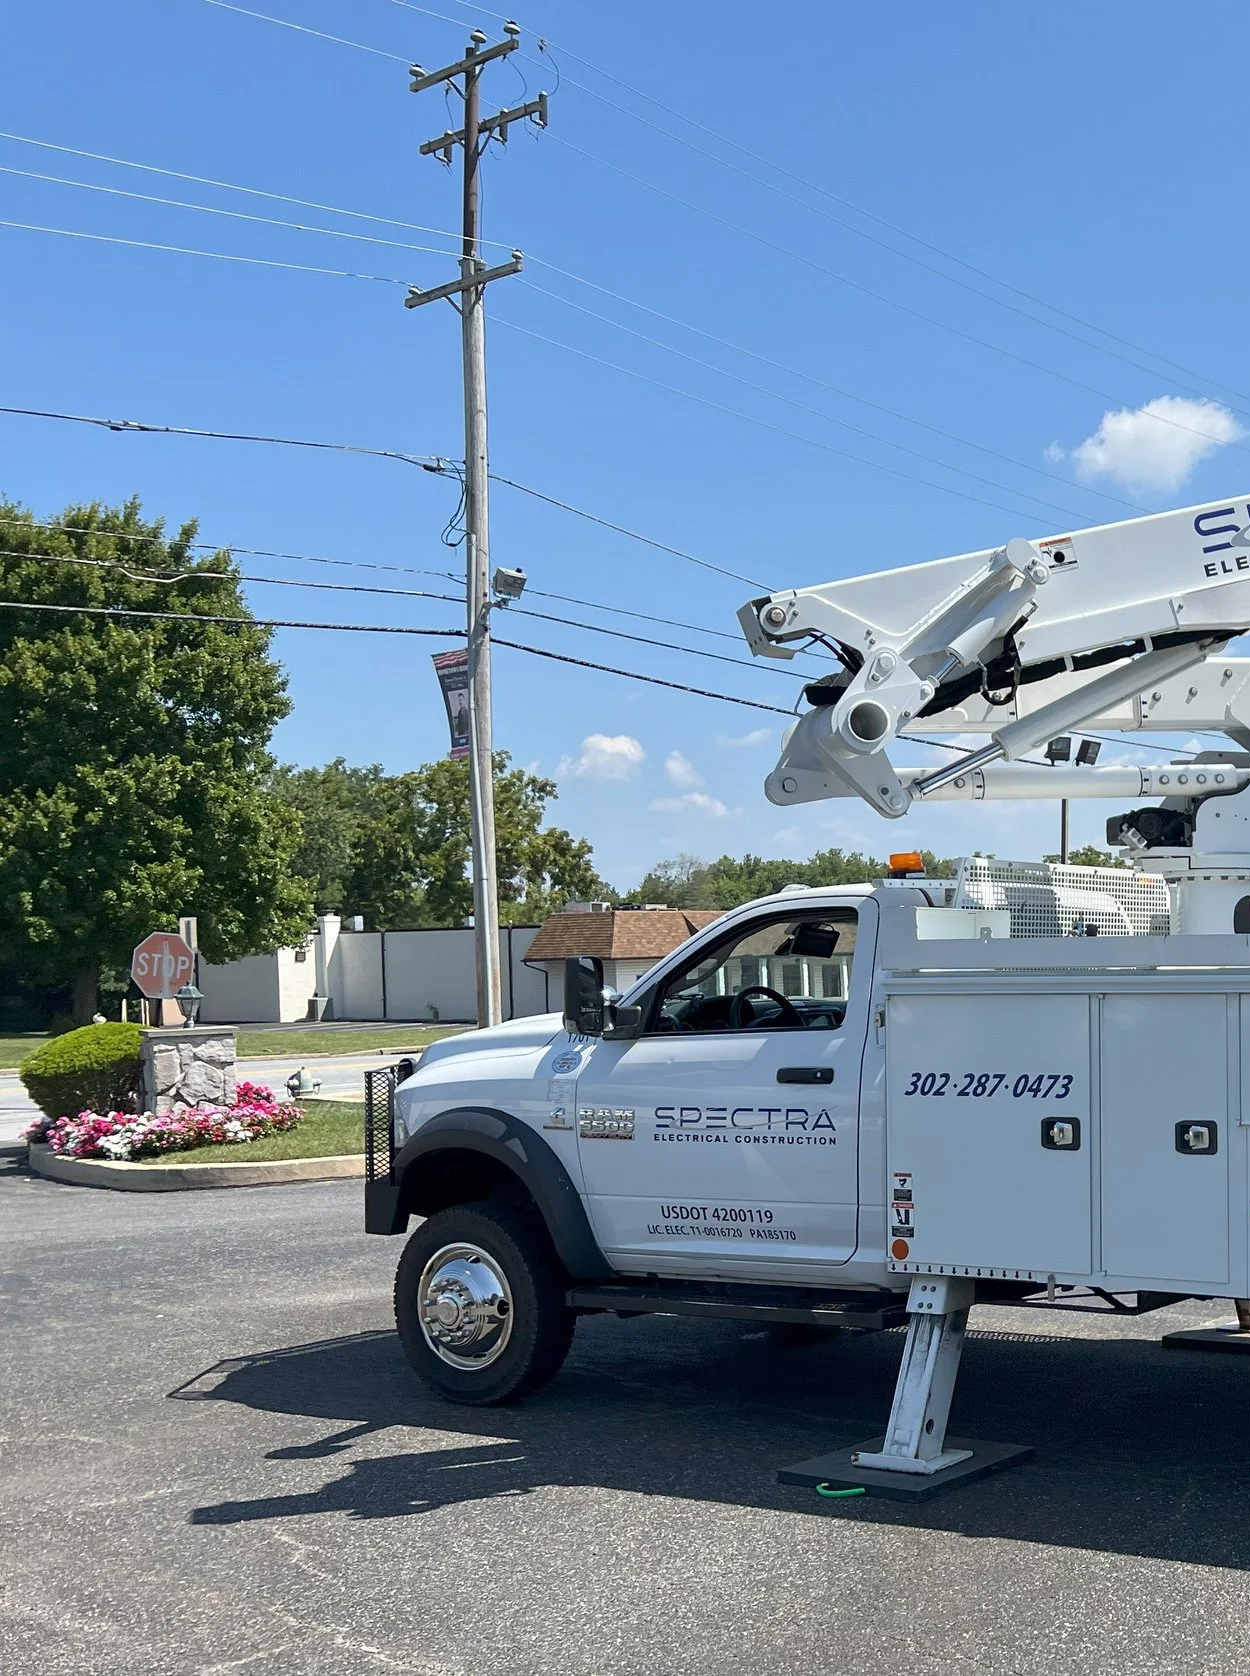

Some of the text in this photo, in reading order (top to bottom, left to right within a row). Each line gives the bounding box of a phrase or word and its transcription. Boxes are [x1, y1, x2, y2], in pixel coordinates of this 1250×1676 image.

[136, 952, 190, 979] STOP
[580, 1108, 635, 1121] RAM
[655, 1107, 836, 1131] SPECTRA
[580, 1121, 635, 1133] 5500
[653, 1134, 837, 1146] ELECTRICAL CONSTRUCTION
[661, 1205, 774, 1224] USDOT 4200119
[647, 1224, 797, 1241] LIC. ELEC. T1-0016720 PA185170
